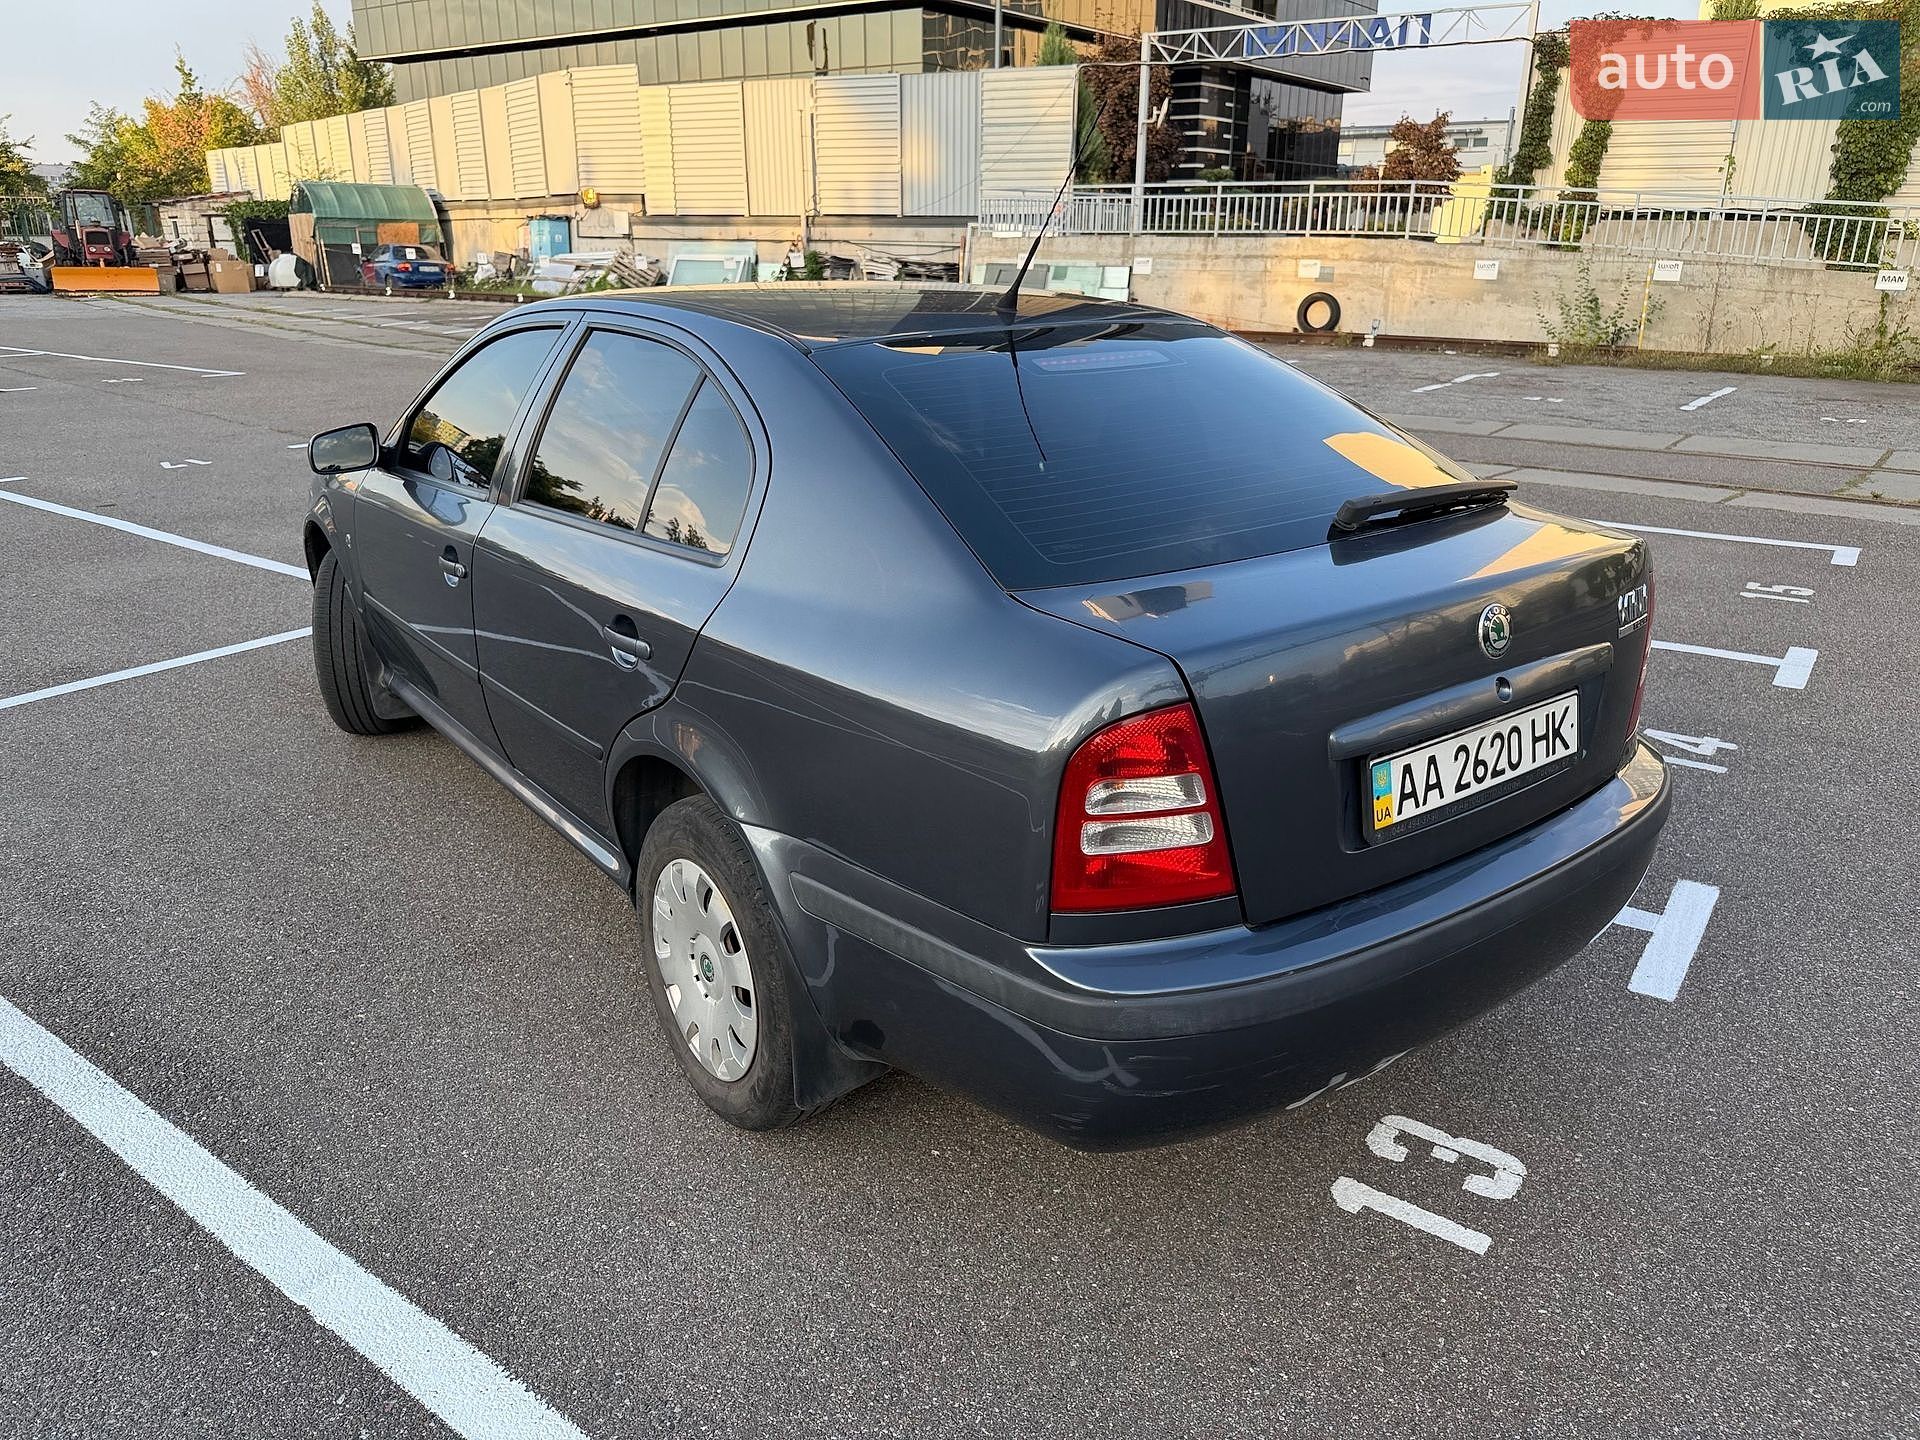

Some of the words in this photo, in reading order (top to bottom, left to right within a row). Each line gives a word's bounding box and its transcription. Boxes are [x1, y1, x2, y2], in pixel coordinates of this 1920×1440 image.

[1881, 275, 1905, 283] MAN
[1740, 581, 1816, 604] 15
[1396, 754, 1445, 817] AA
[1453, 724, 1523, 795] 2620
[1530, 705, 1571, 764] HK
[1375, 805, 1392, 823] UA
[1329, 1114, 1528, 1256] 13
